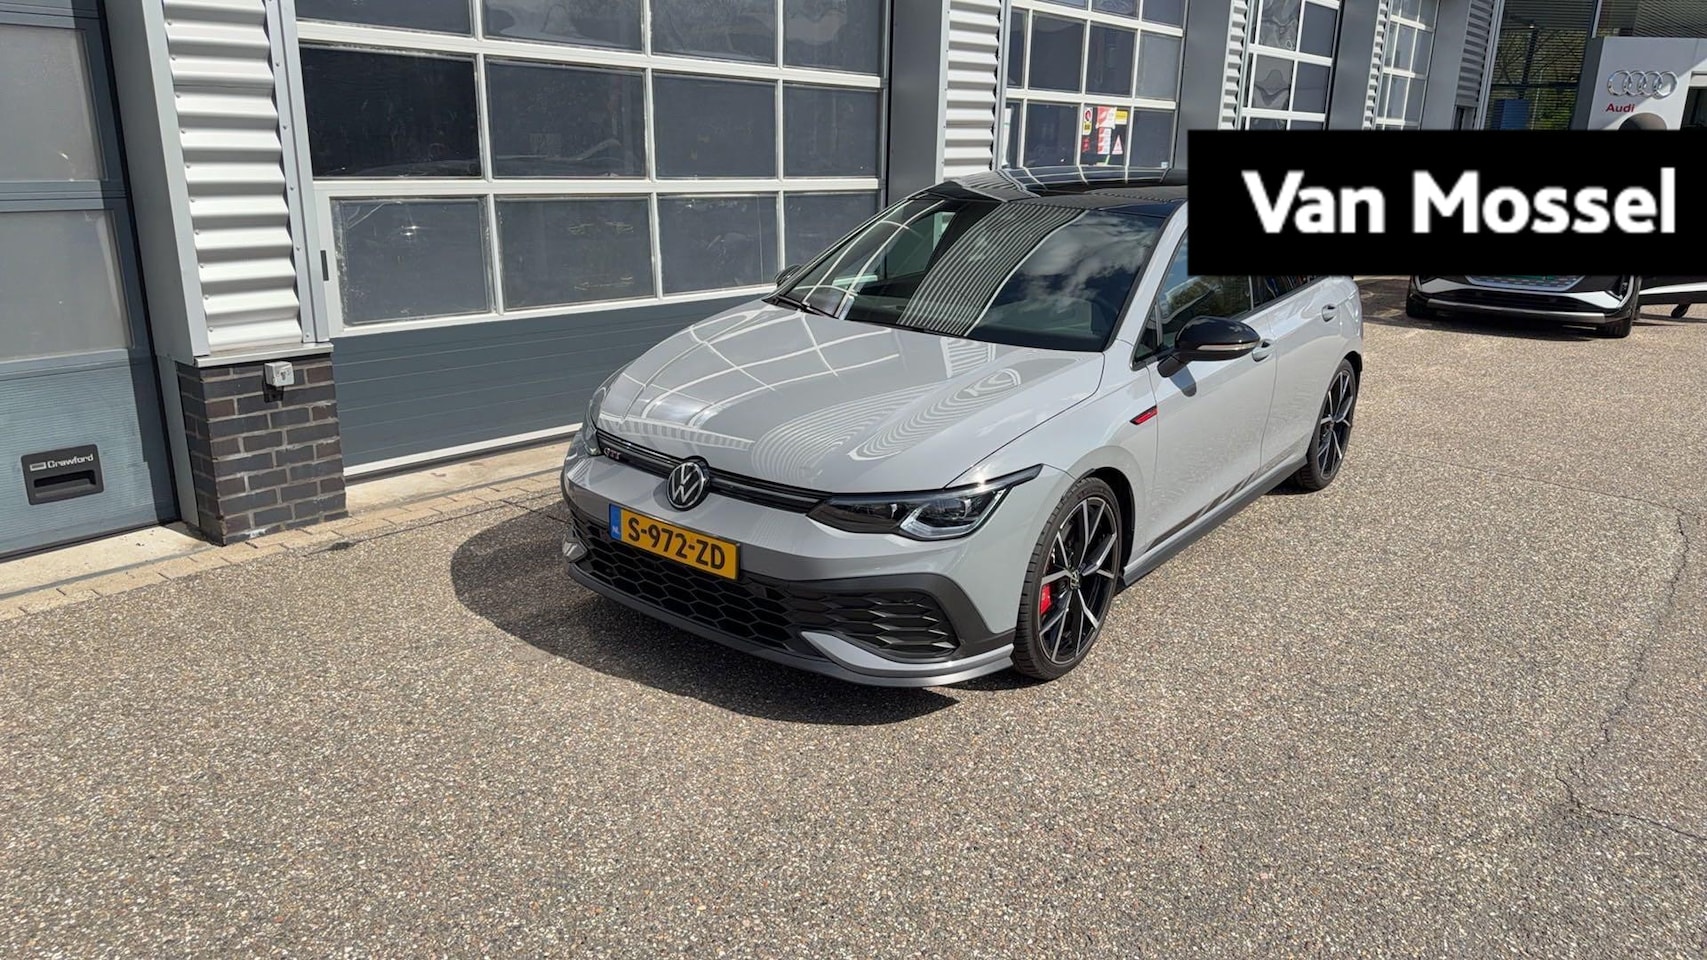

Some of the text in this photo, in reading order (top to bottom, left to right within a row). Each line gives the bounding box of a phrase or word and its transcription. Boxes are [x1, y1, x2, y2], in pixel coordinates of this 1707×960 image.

[1605, 103, 1636, 113] Audi
[604, 447, 621, 460] GTI
[47, 453, 94, 469] Crawford
[628, 517, 726, 570] S-972-ZD
